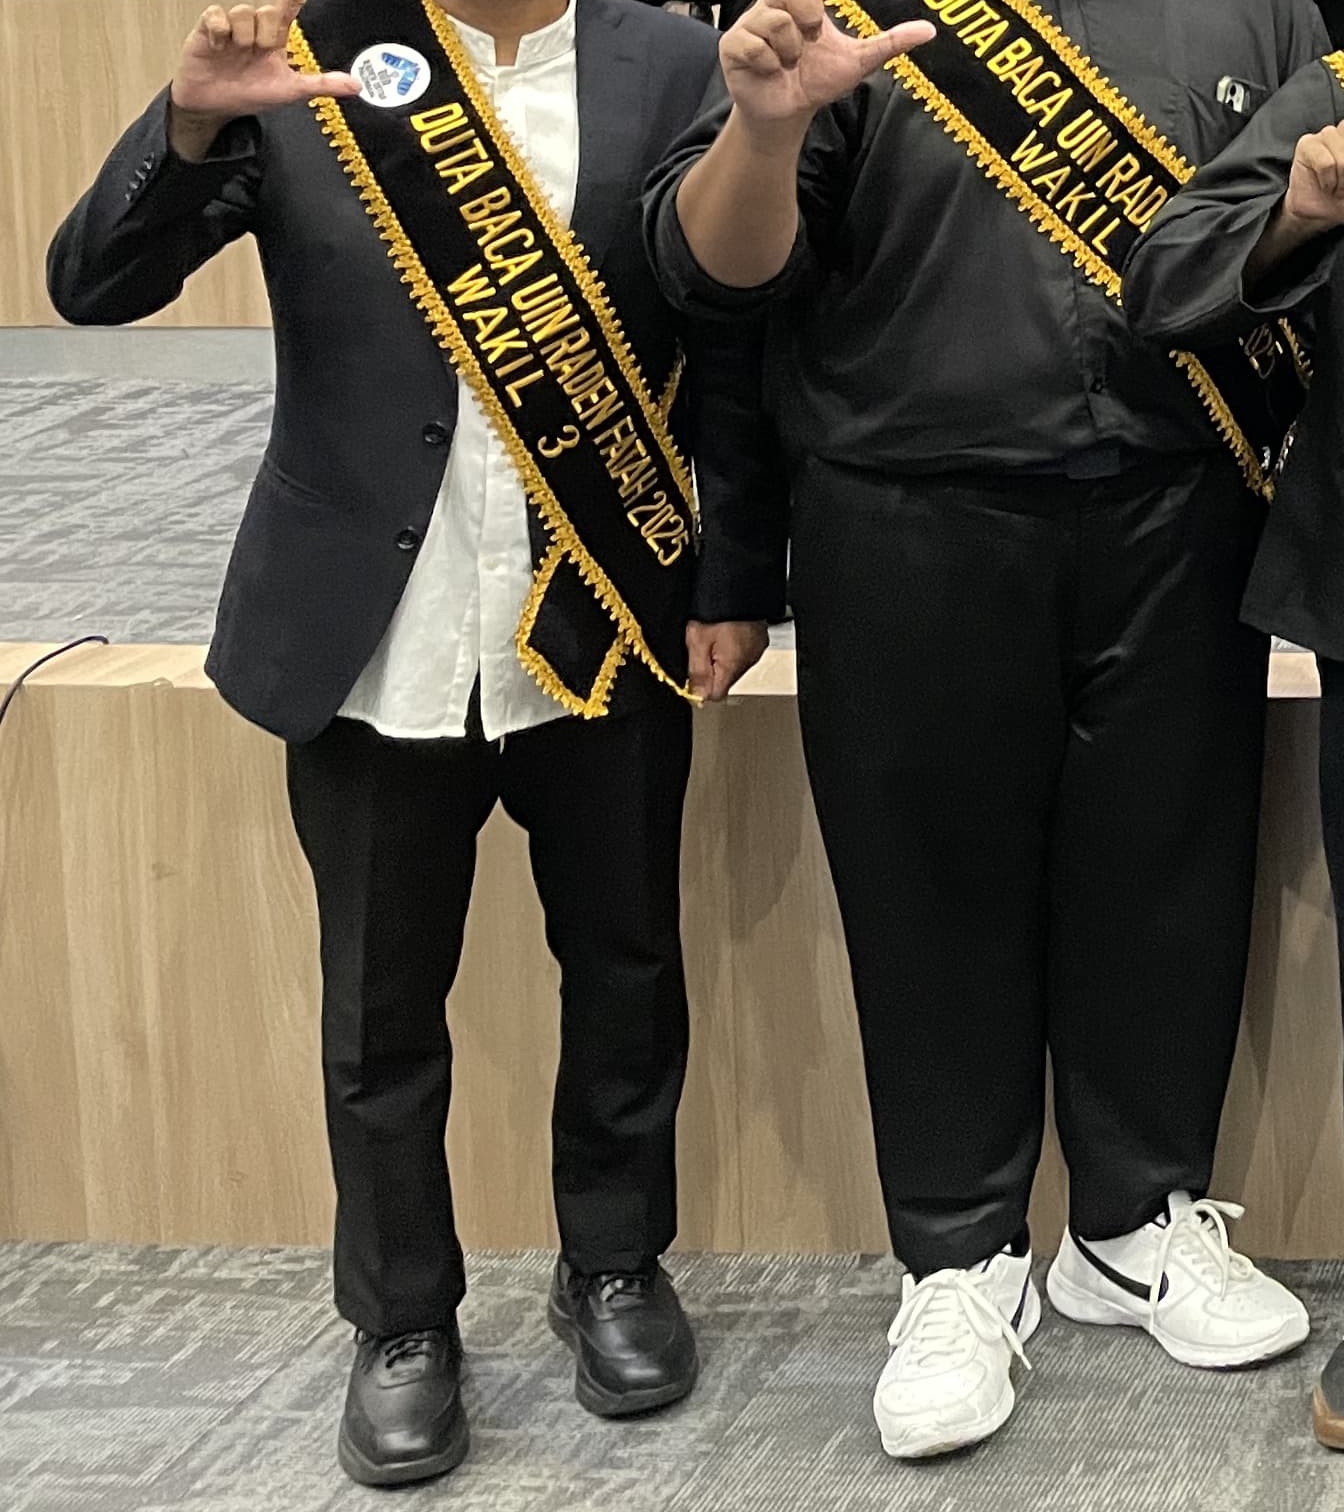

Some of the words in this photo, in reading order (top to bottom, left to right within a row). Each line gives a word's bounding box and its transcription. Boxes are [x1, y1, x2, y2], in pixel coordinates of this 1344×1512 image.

[408, 100, 496, 197] DUTA
[986, 36, 1073, 130] BACA
[1056, 108, 1119, 174] UIN
[1095, 152, 1168, 234] RAD
[458, 184, 544, 282] BACA
[1010, 129, 1123, 256] WAKIL
[509, 271, 573, 342] UIN
[447, 262, 547, 409] WAKIL
[537, 424, 581, 462] 3
[537, 326, 621, 431] RADEN
[595, 409, 660, 514] FATAH
[625, 487, 690, 568] 2025
